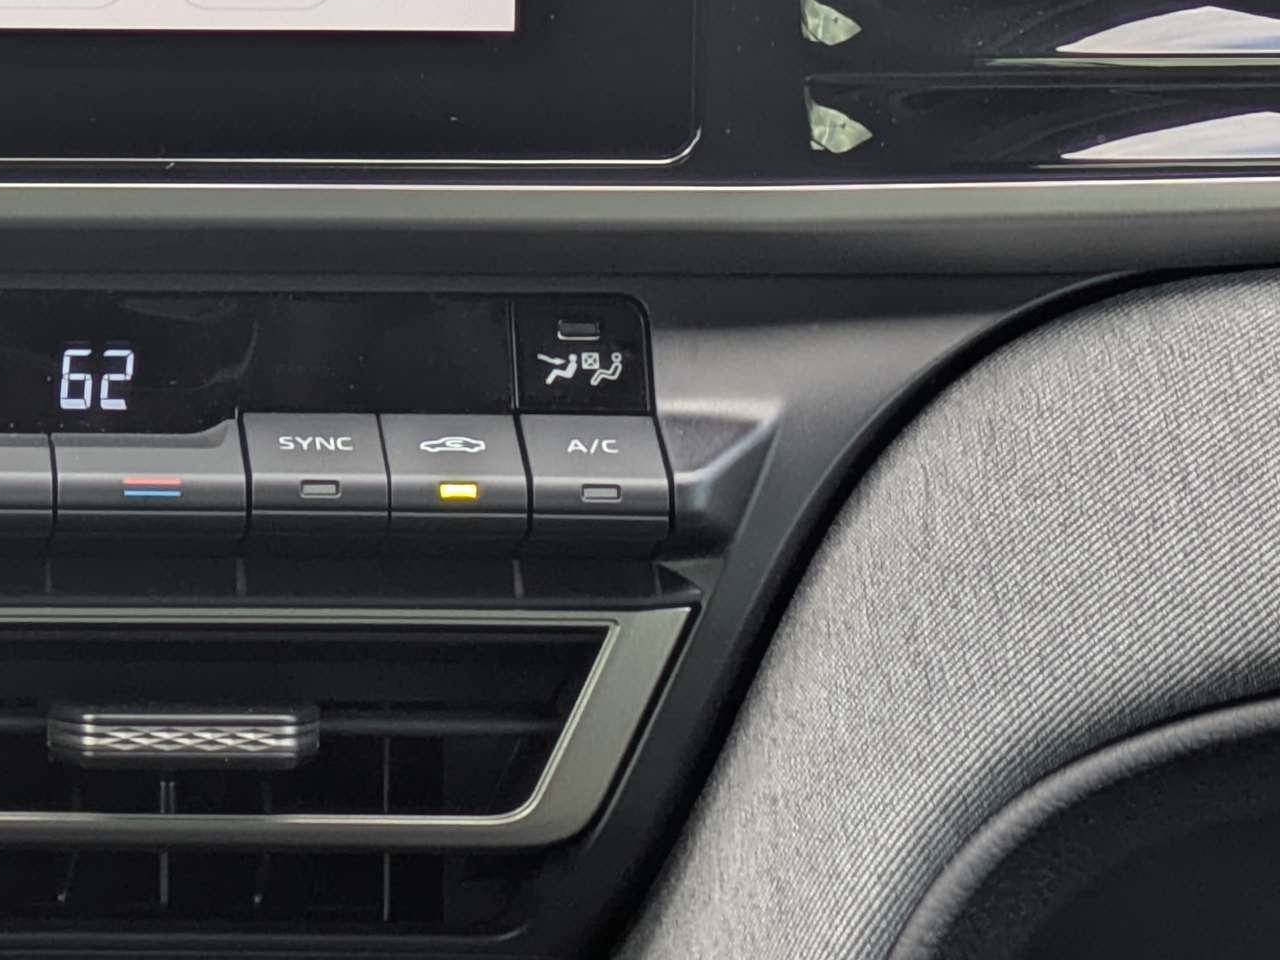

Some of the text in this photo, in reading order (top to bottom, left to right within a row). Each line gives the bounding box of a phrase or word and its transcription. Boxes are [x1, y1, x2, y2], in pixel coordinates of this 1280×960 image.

[59, 348, 135, 411] 62
[278, 435, 354, 452] SYNC
[566, 438, 619, 455] A/C
